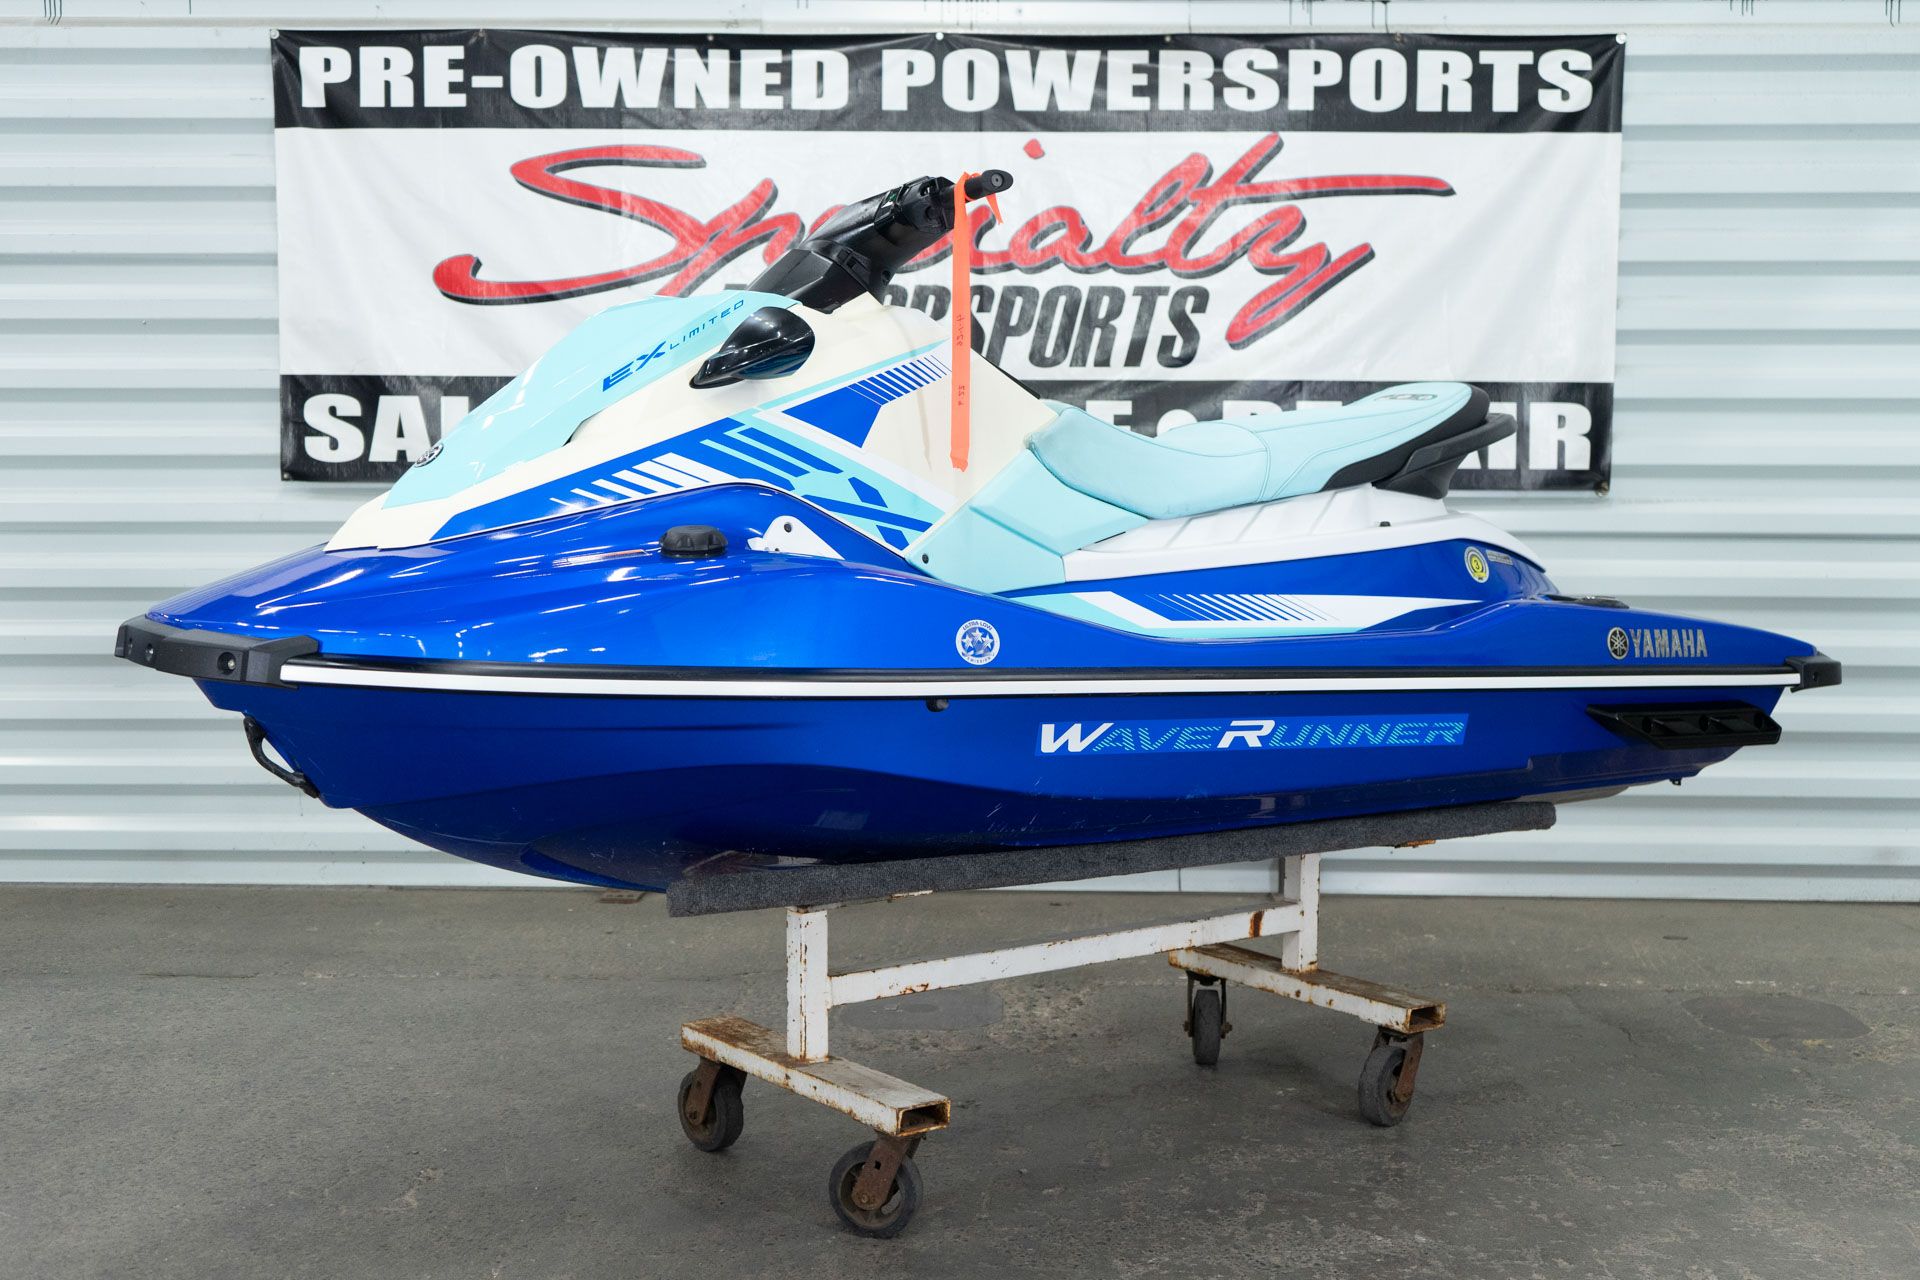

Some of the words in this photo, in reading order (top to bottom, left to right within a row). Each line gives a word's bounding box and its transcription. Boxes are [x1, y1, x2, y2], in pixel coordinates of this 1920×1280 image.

[299, 45, 849, 111] PRE-OWNED
[881, 48, 1594, 114] POWERSPORTS
[433, 131, 1456, 350] Spialty
[602, 340, 667, 392] EX
[669, 299, 744, 350] LIMITED
[1628, 628, 1708, 658] YAMAHA
